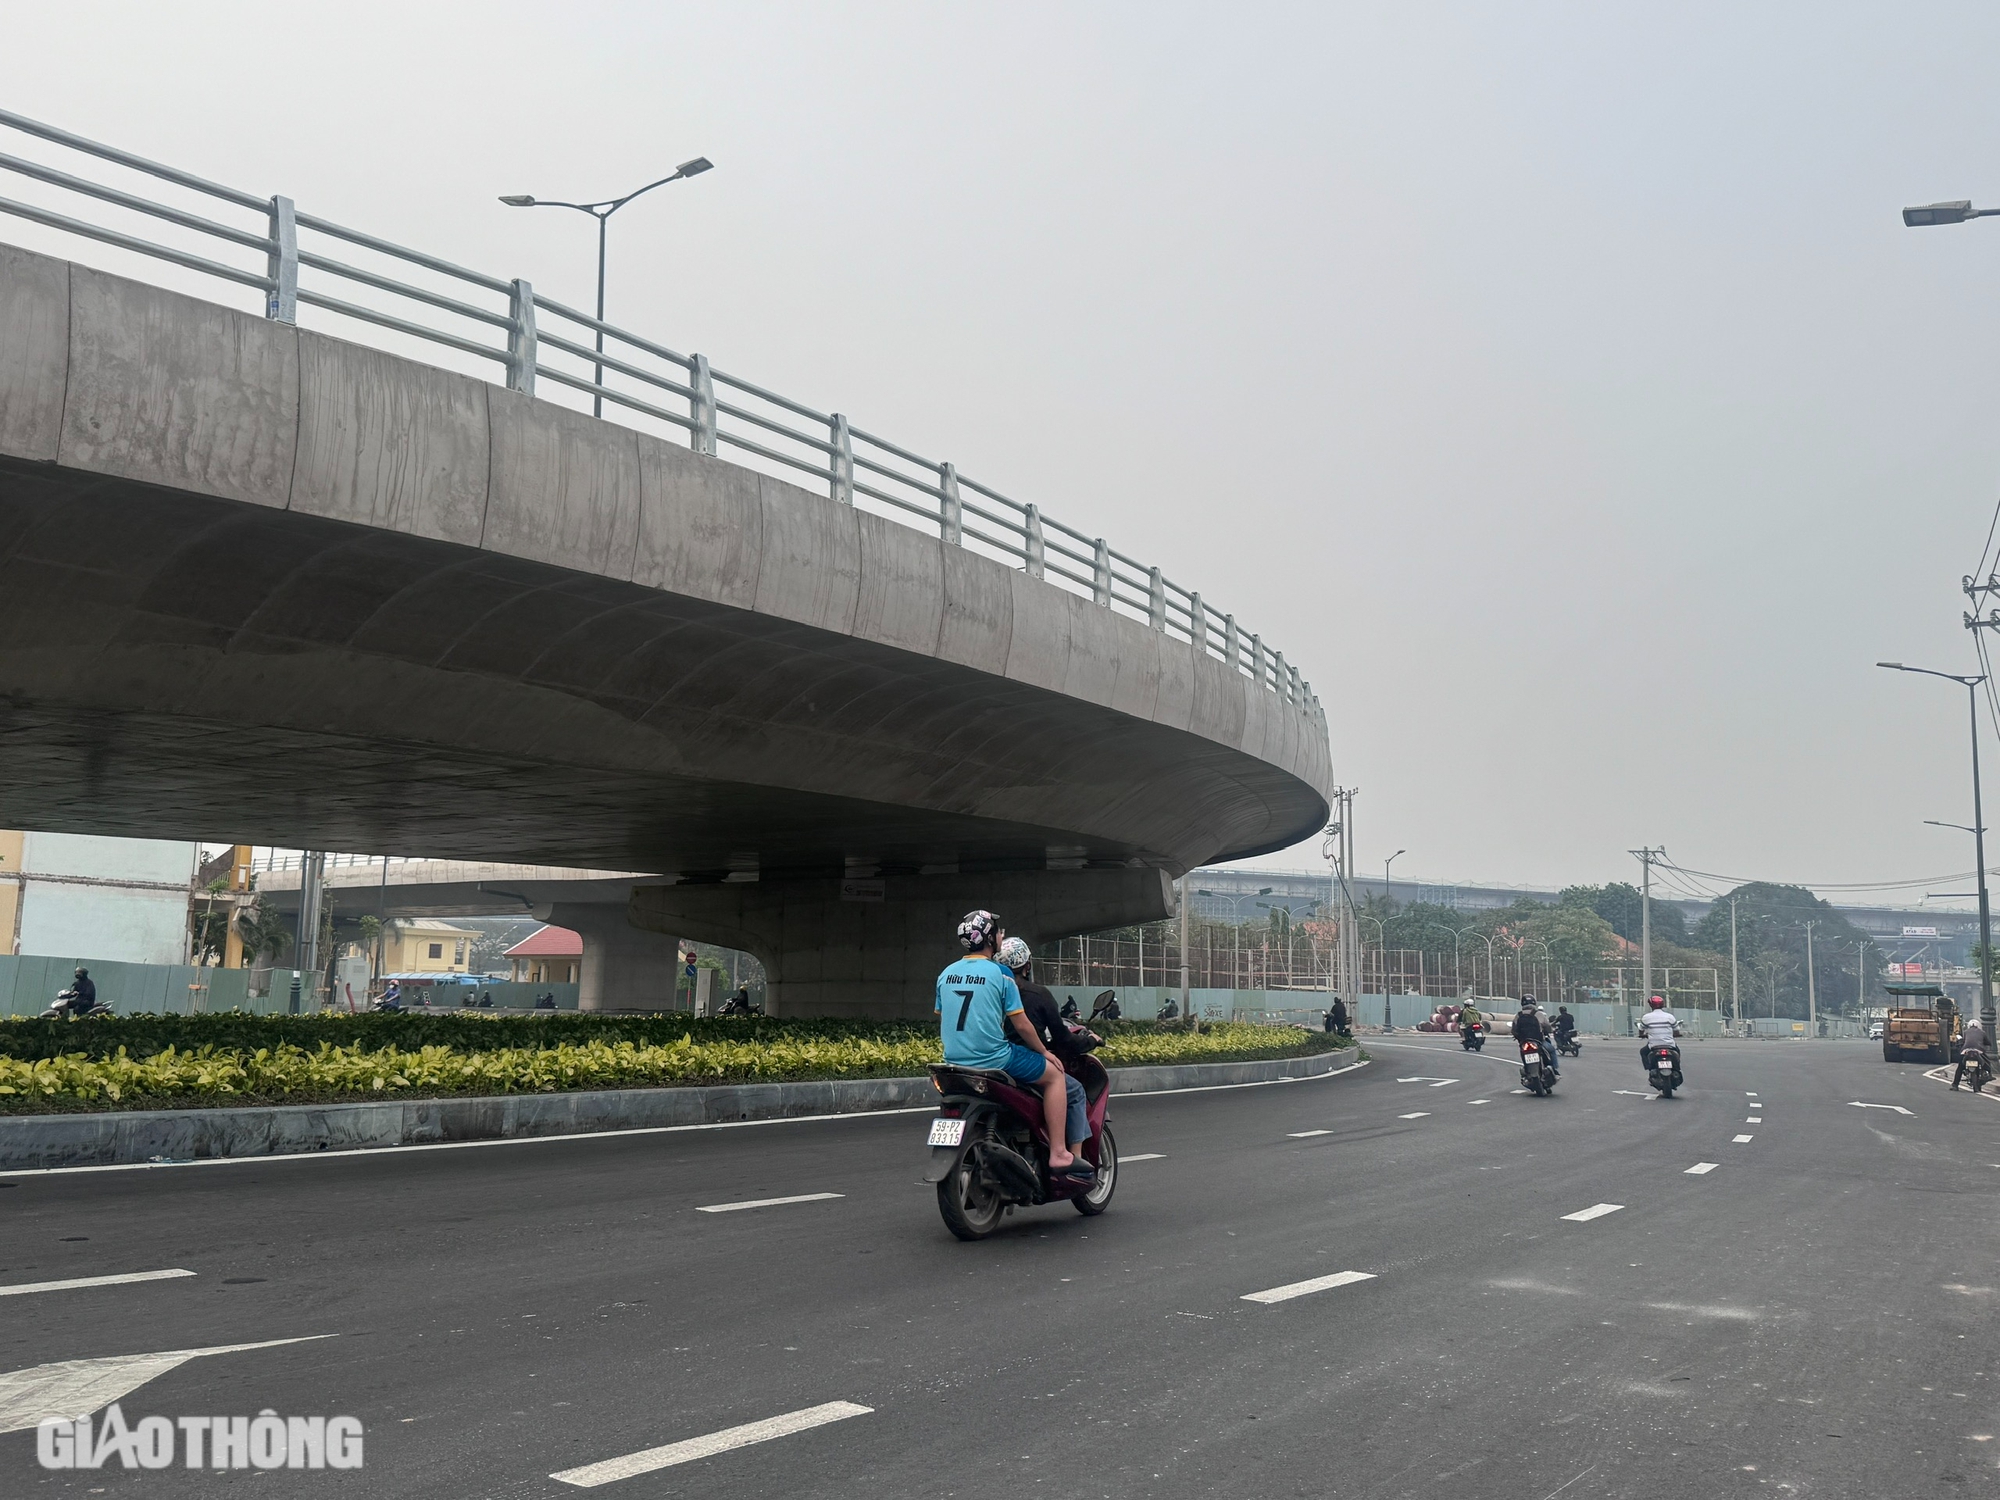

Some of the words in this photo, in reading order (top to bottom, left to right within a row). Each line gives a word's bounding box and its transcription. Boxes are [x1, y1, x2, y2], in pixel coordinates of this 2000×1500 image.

[946, 974, 963, 985] Hữu
[965, 974, 986, 986] Toàn
[952, 990, 974, 1031] 7
[936, 1121, 961, 1132] 59-P2
[930, 1132, 960, 1144] 833.15
